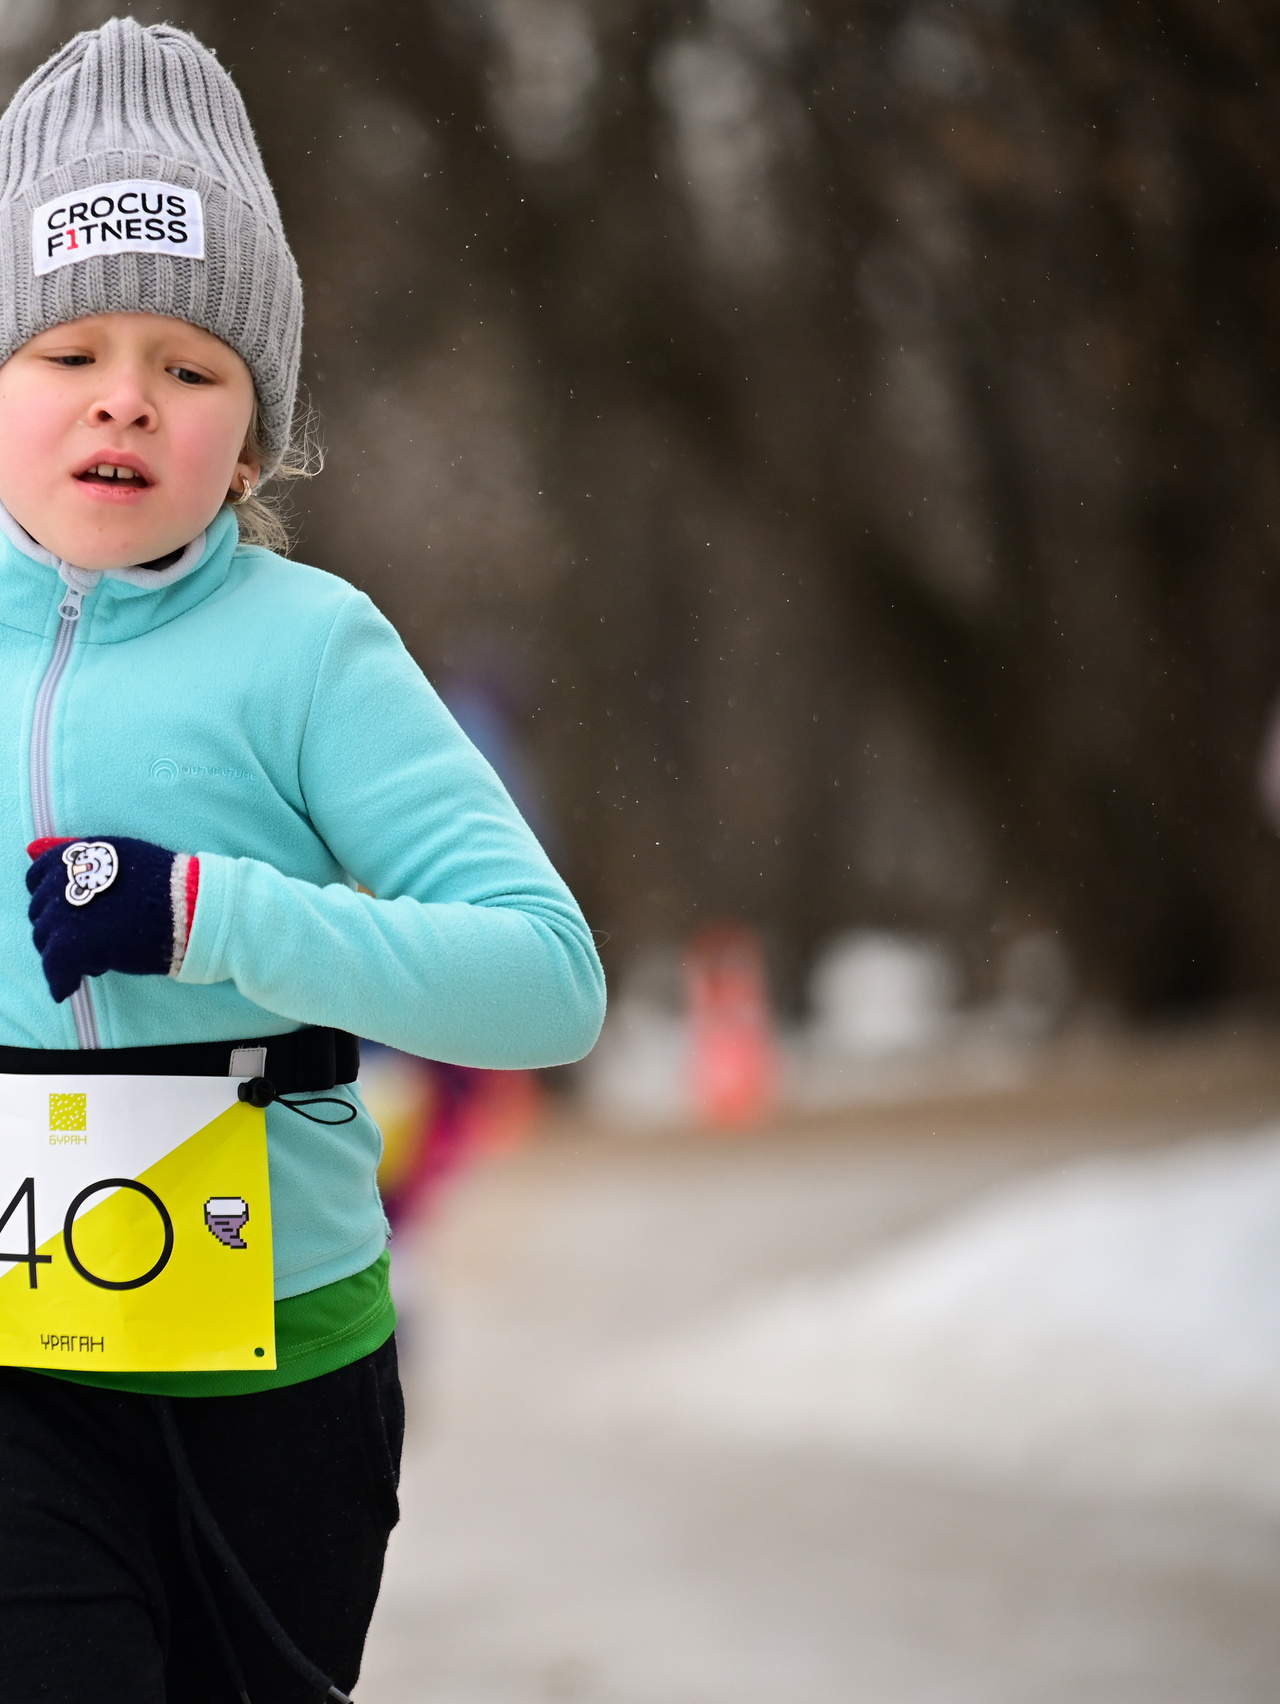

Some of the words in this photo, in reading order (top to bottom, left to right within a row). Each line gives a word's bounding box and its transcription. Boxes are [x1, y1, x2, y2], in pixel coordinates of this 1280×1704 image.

[46, 192, 187, 230] CROCUS
[48, 1134, 88, 1146] БУРАН
[39, 1333, 105, 1353] УРАГАН
